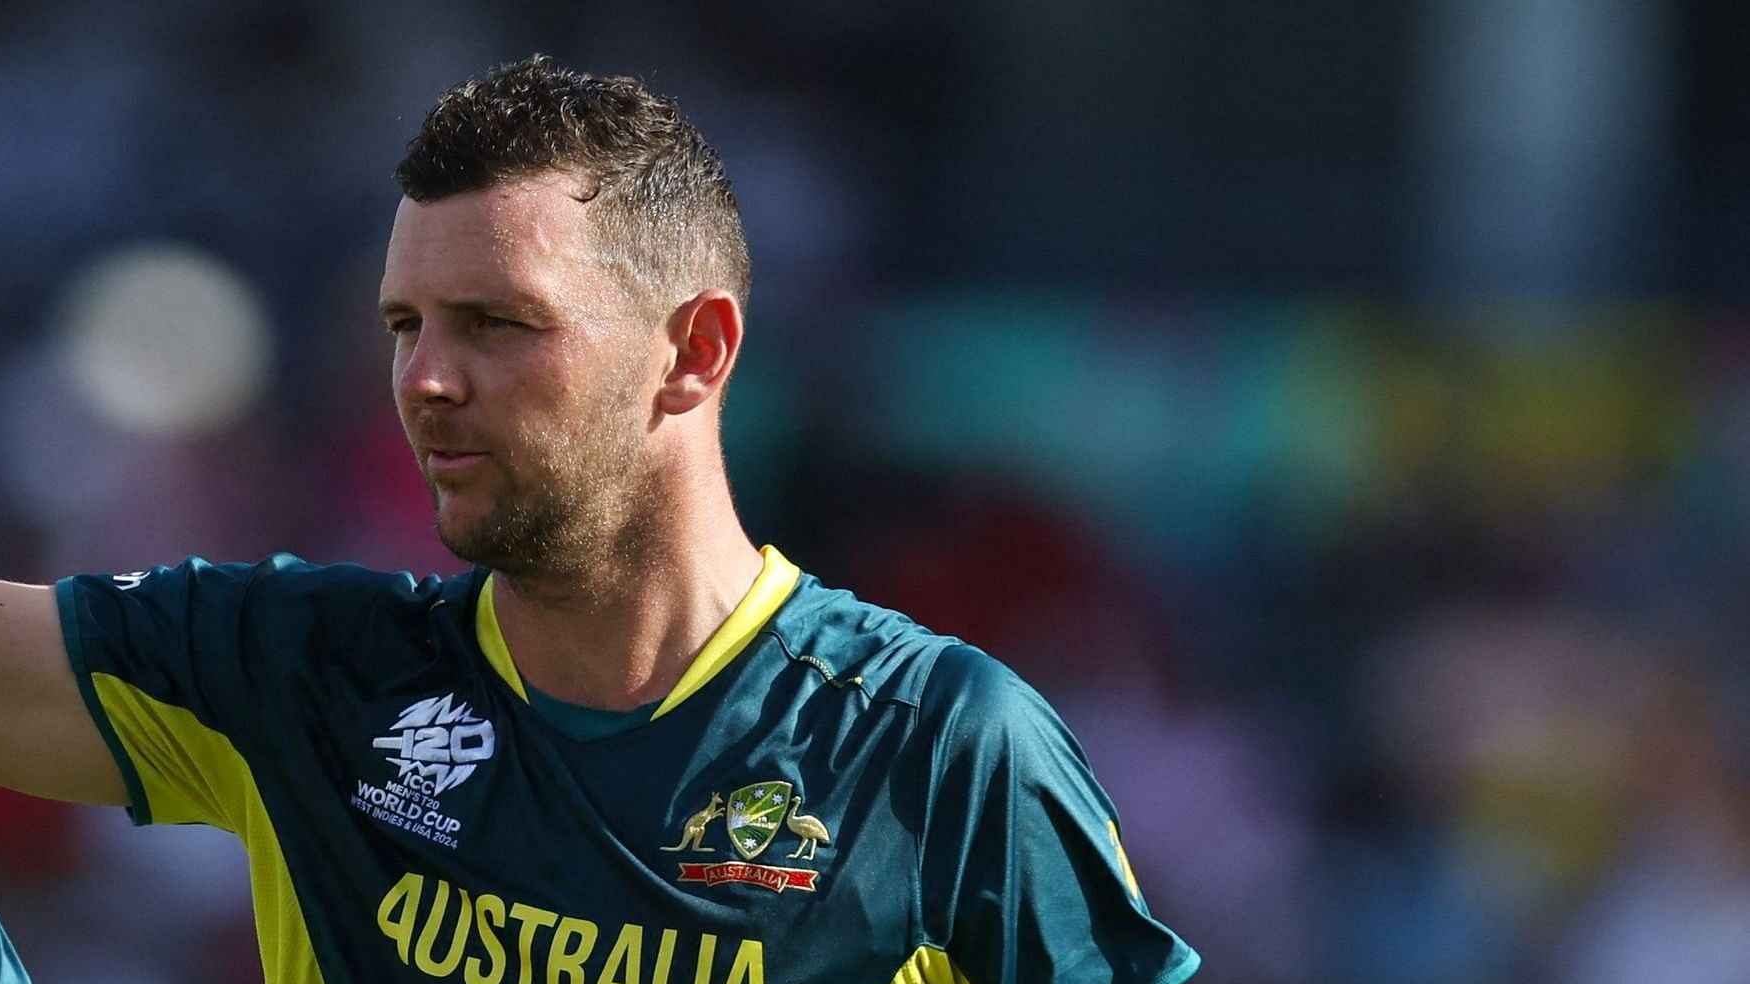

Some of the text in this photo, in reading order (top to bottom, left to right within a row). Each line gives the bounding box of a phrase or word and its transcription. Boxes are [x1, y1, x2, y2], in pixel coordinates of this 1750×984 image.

[385, 780, 440, 810] MEN'S T20
[403, 772, 435, 795] ICC
[351, 794, 459, 850] WEST INDIES & USA 2024
[358, 780, 461, 834] WORLD CUP
[708, 865, 783, 889] AUSTRALIA
